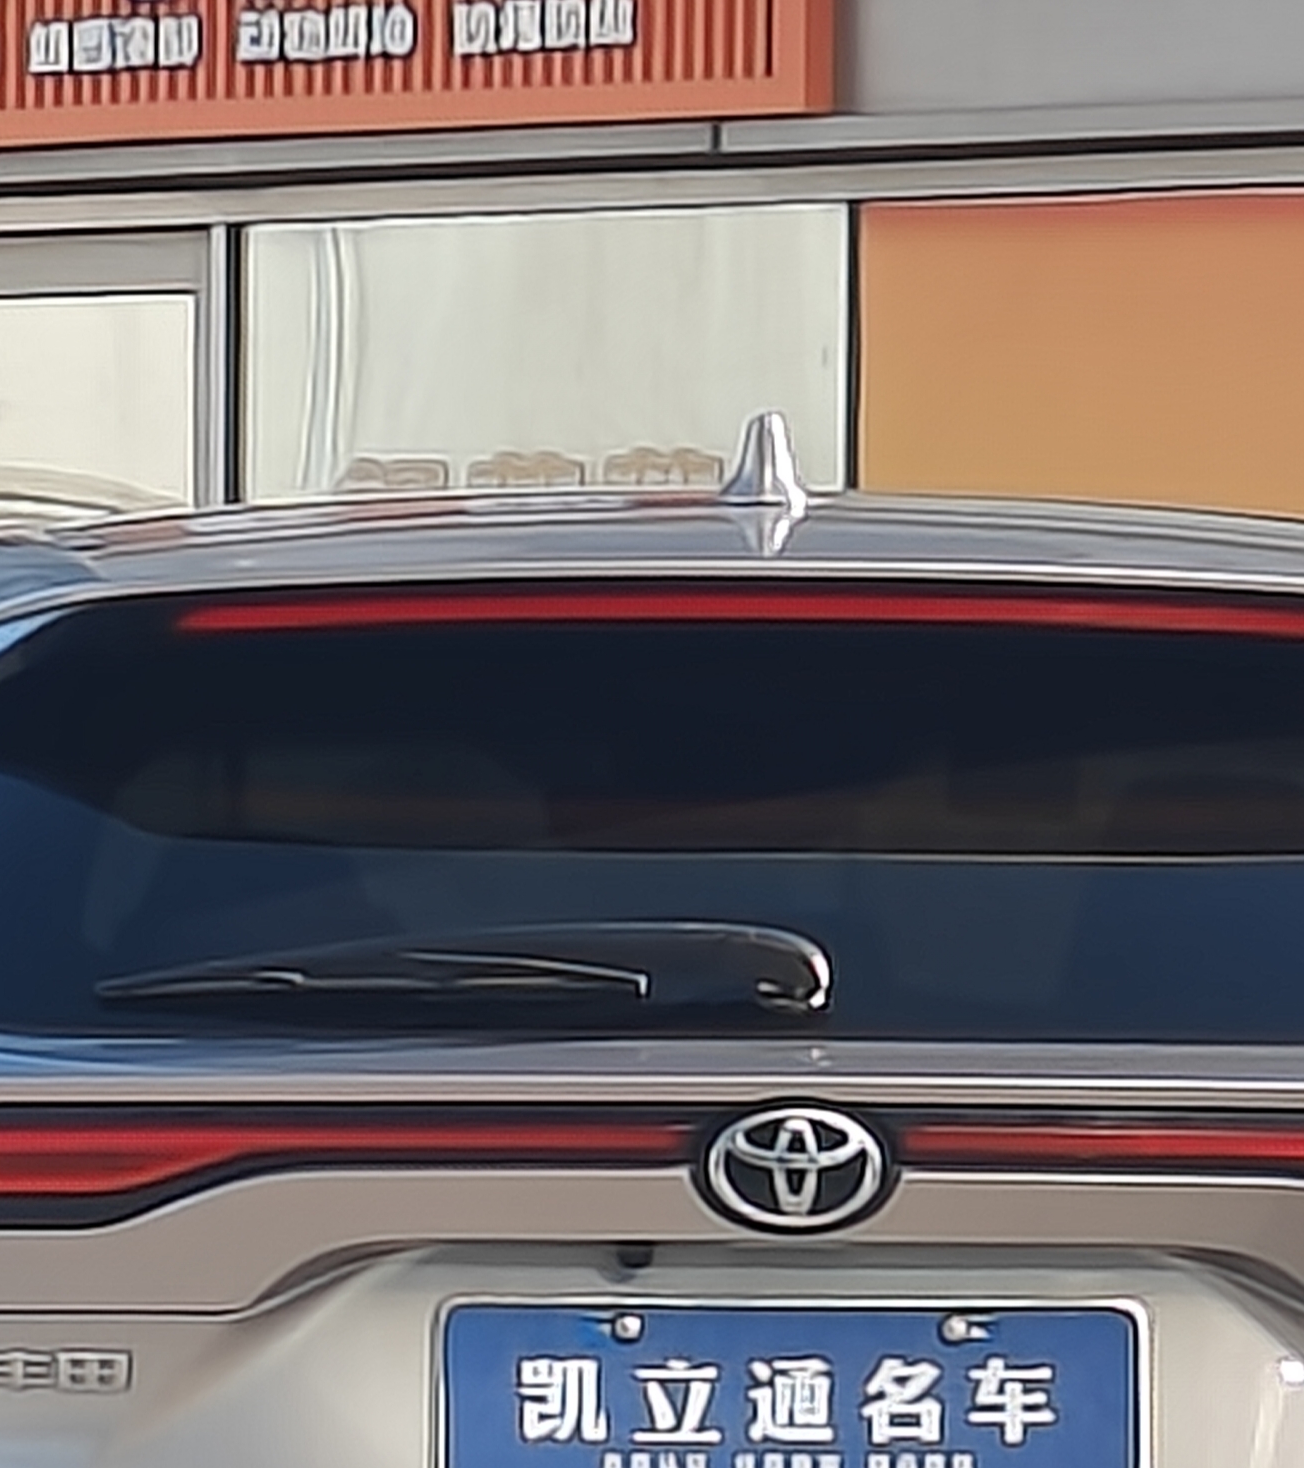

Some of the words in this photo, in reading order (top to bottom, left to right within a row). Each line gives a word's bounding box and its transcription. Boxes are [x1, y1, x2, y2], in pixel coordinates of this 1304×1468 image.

[518, 1357, 1058, 1445] 凯立通名车
